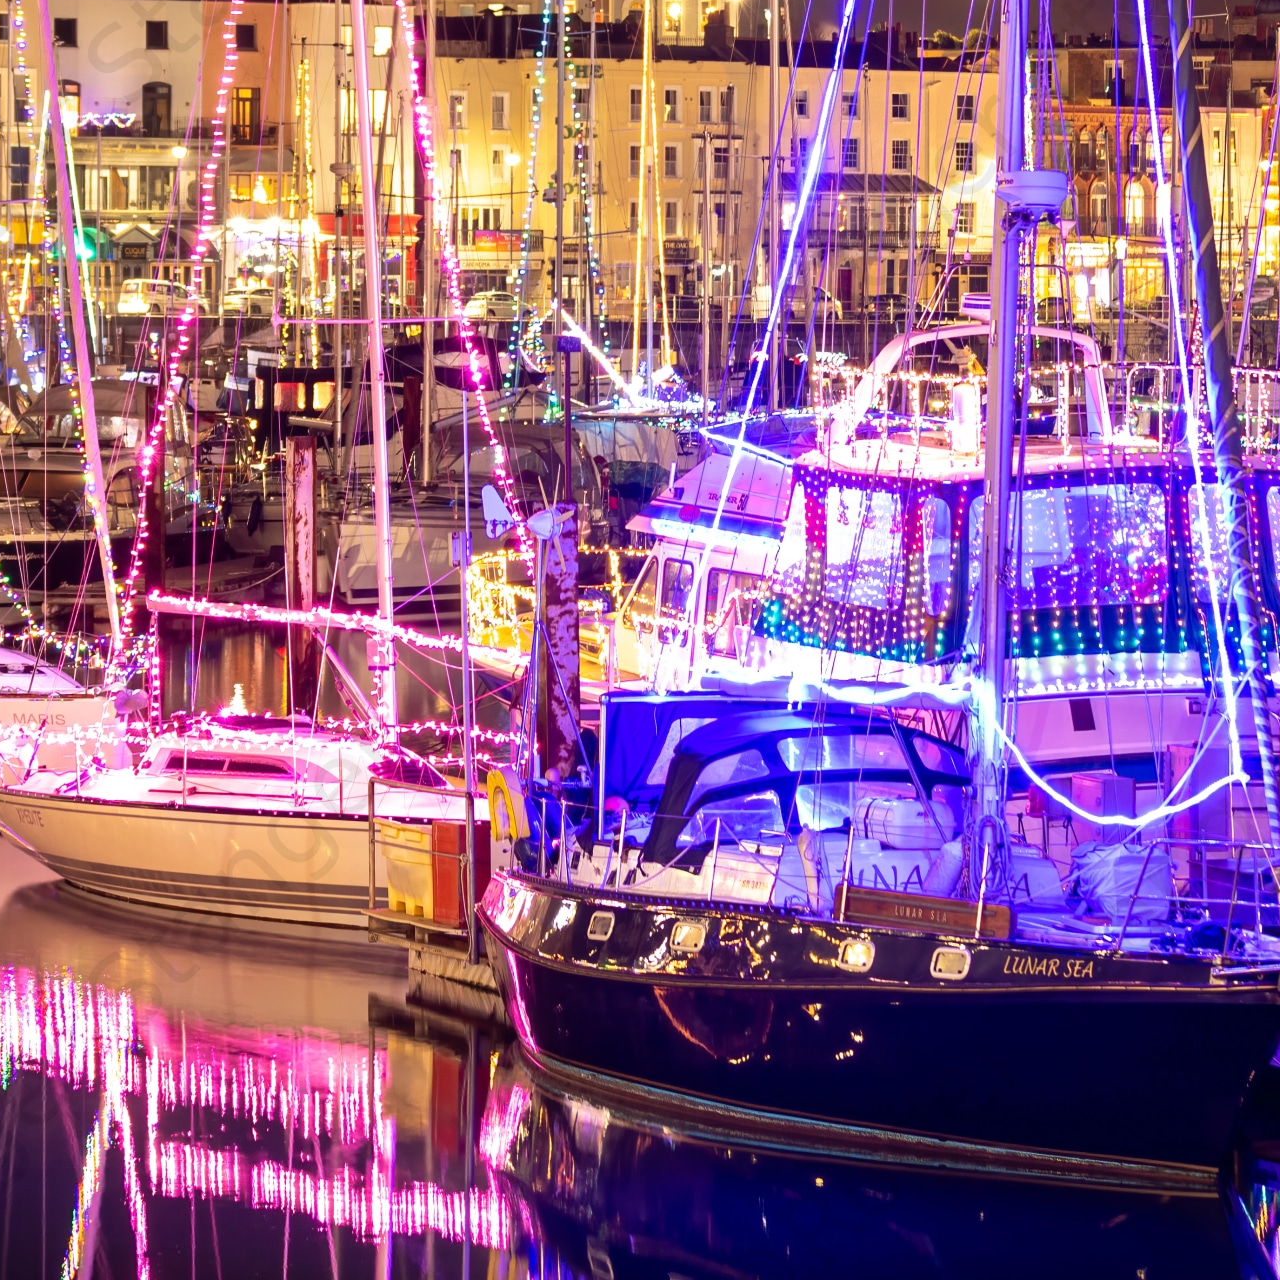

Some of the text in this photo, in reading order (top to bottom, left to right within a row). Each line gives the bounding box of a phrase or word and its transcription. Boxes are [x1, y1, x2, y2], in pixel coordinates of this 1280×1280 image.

[708, 492, 738, 505] TRER
[13, 713, 66, 726] MARIS
[895, 905, 948, 922] LUNAR SEA
[1003, 955, 1094, 979] LUNAR SEA
